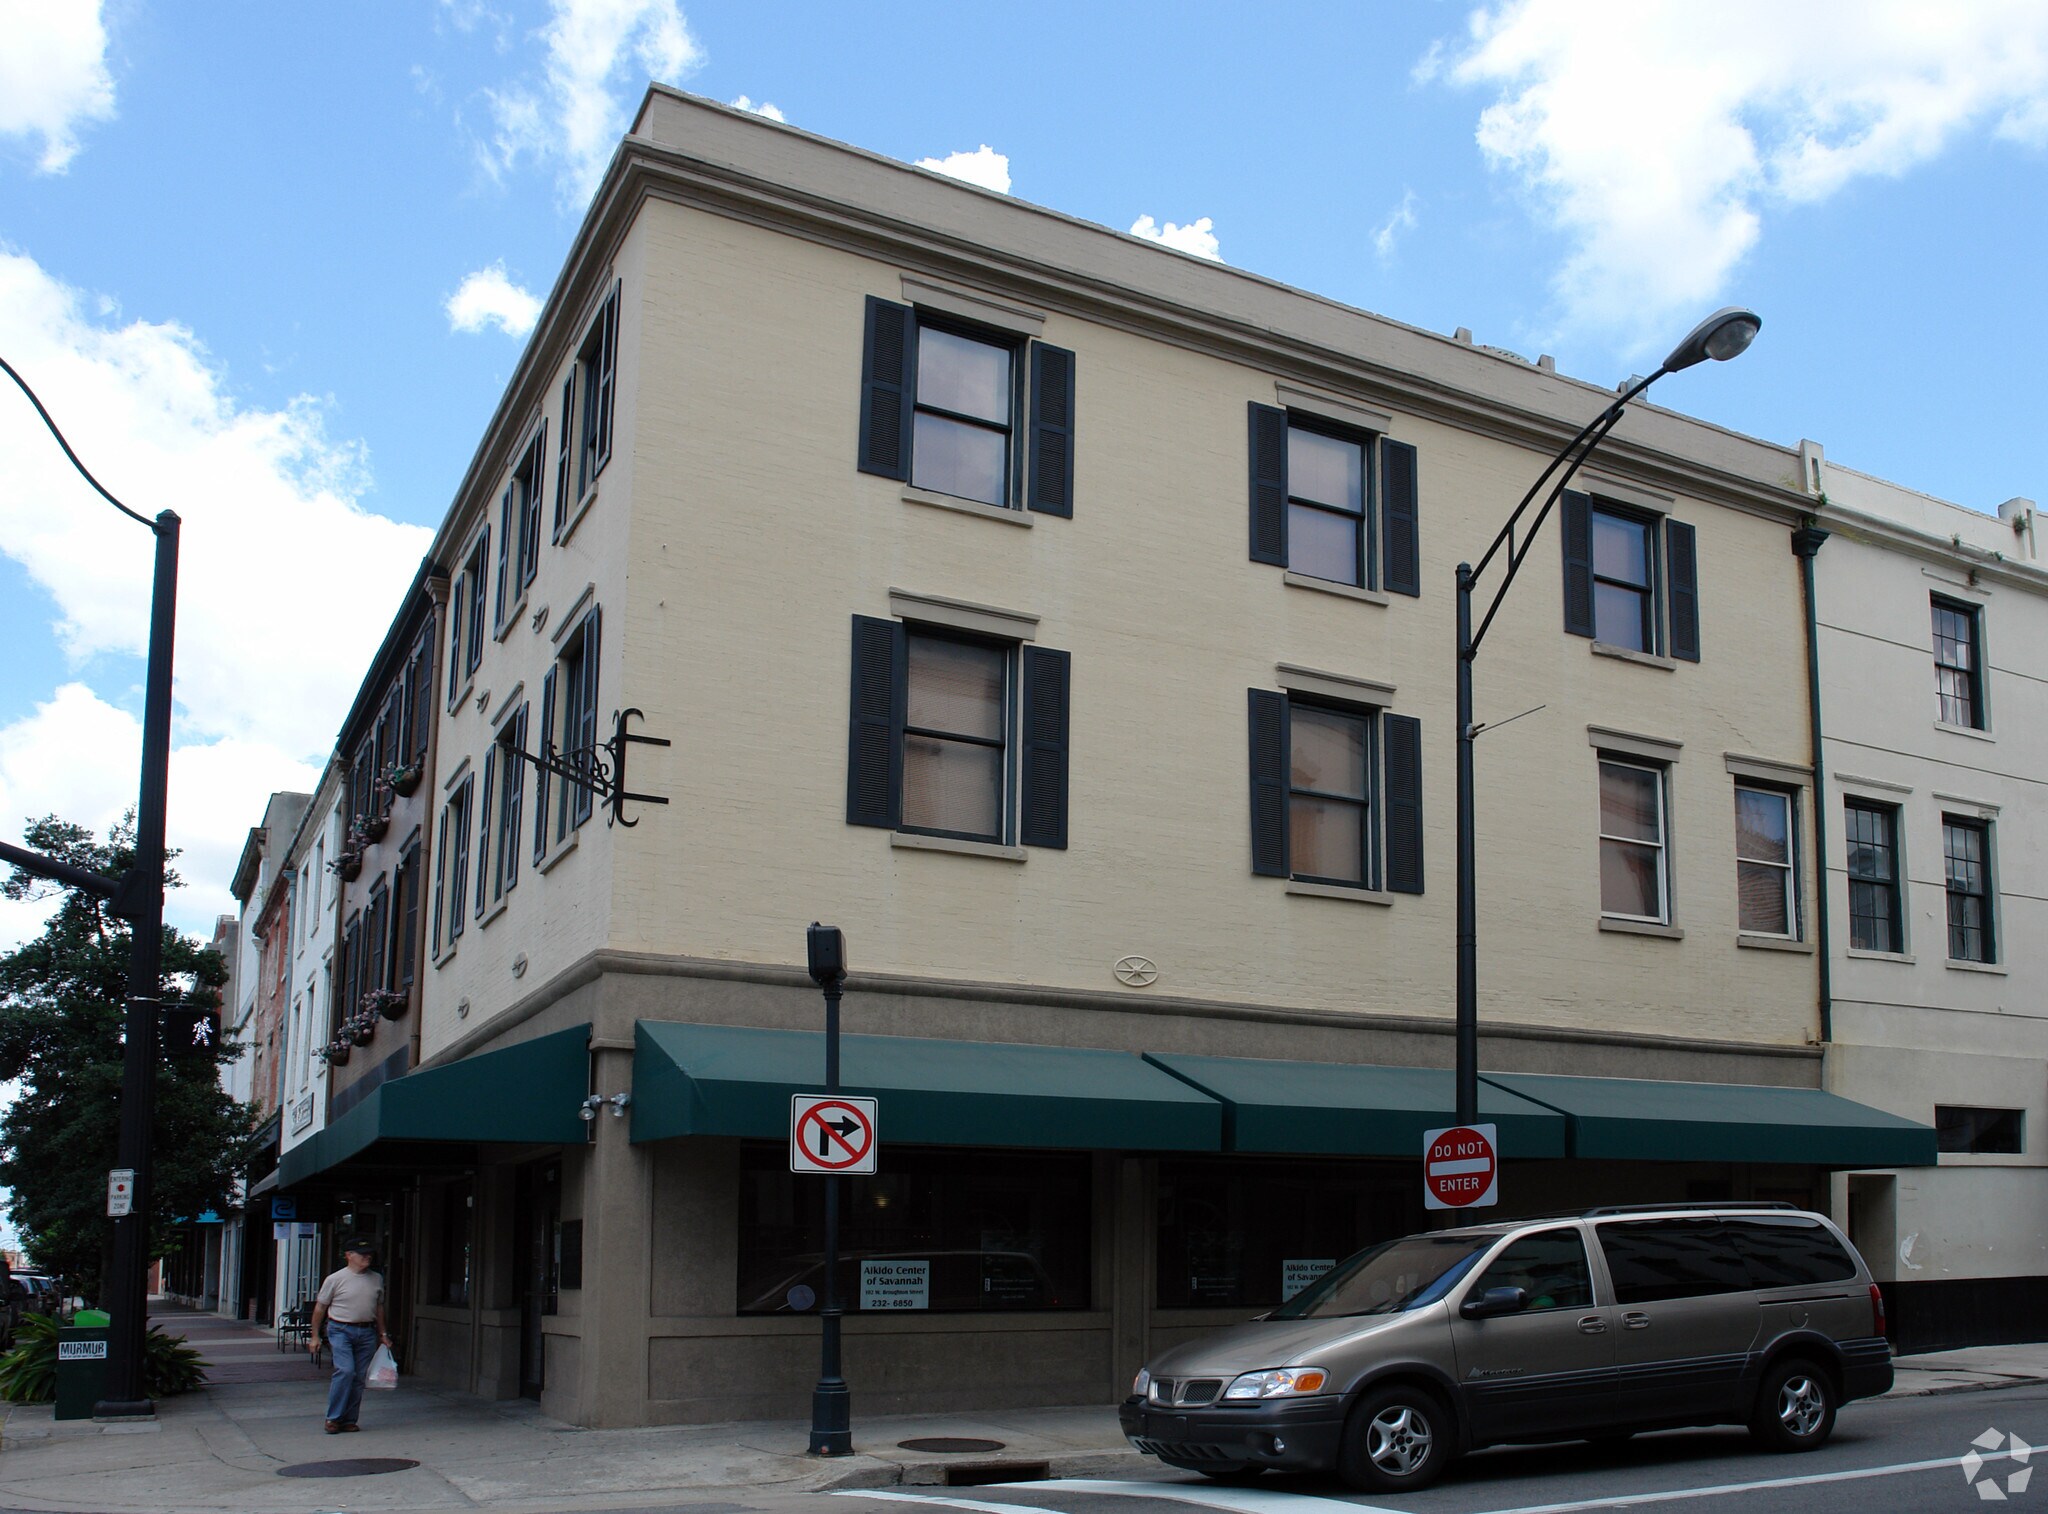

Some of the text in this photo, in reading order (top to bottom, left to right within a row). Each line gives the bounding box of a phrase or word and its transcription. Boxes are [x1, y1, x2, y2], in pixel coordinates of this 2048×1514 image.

[1435, 1141, 1484, 1158] DO NOT
[1440, 1177, 1480, 1192] ENTER
[864, 1265, 926, 1274] Aikido Center
[866, 1276, 923, 1285] of Savannah
[893, 1299, 913, 1307] 6850
[61, 1342, 105, 1355] MURMUR
